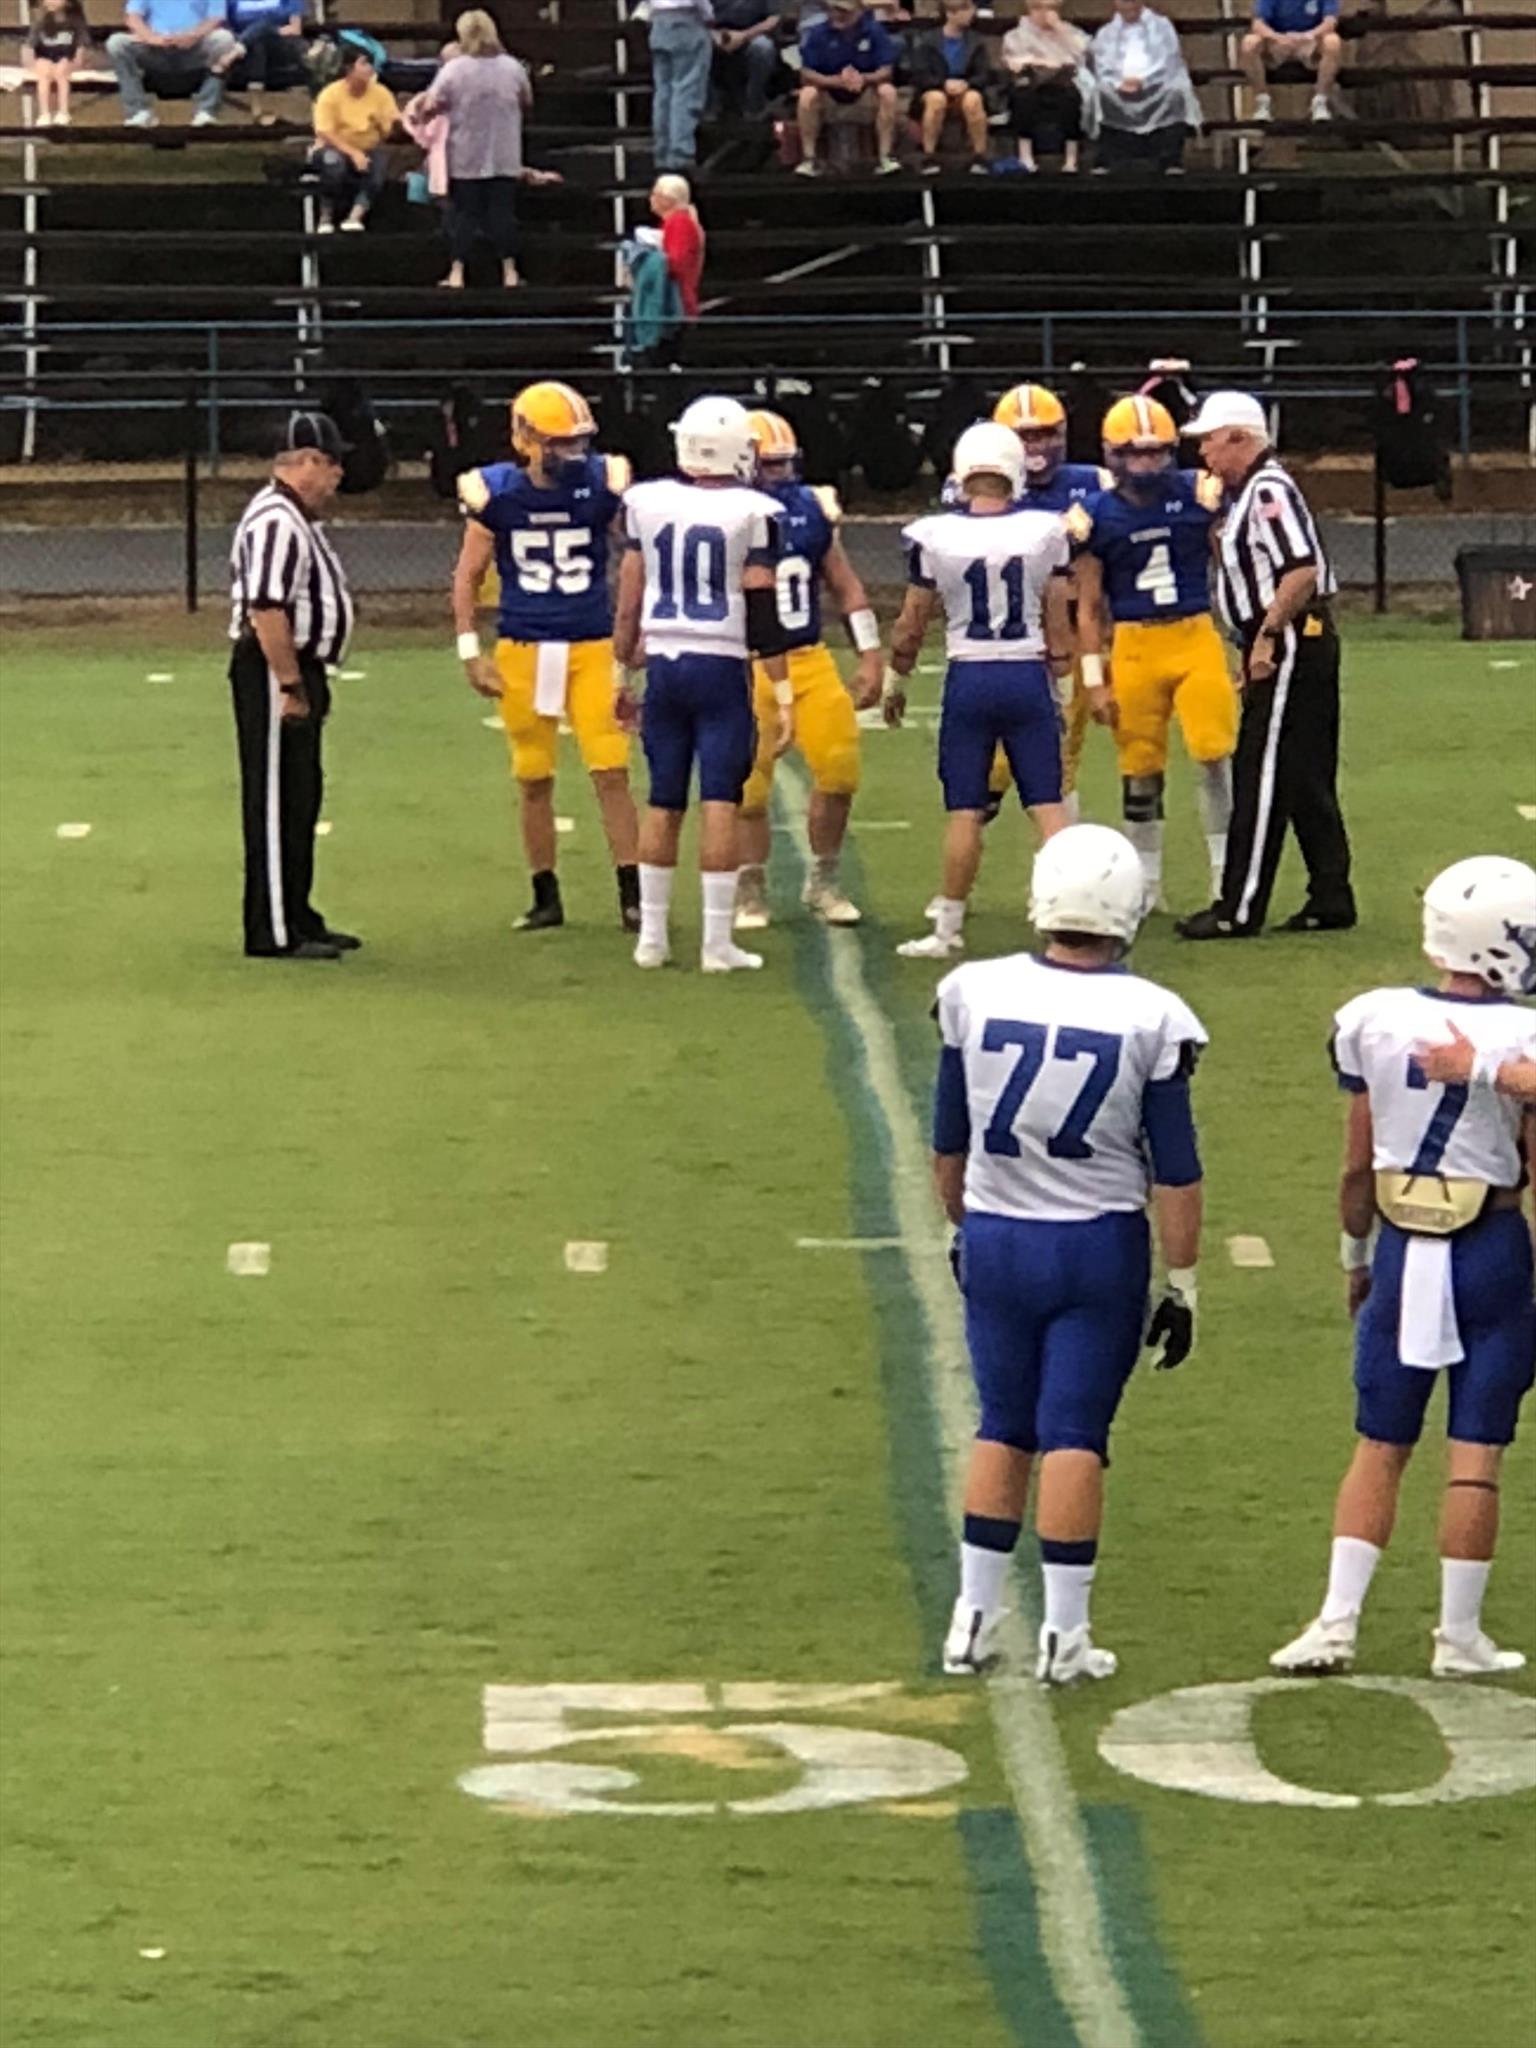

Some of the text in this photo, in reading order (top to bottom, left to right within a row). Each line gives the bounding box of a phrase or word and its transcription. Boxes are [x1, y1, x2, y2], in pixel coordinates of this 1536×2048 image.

[511, 527, 594, 594] 55
[651, 523, 730, 622] 10
[964, 556, 1027, 640] 11
[1136, 544, 1178, 605] 4
[982, 1018, 1123, 1158] 77
[1406, 1042, 1470, 1174] 7
